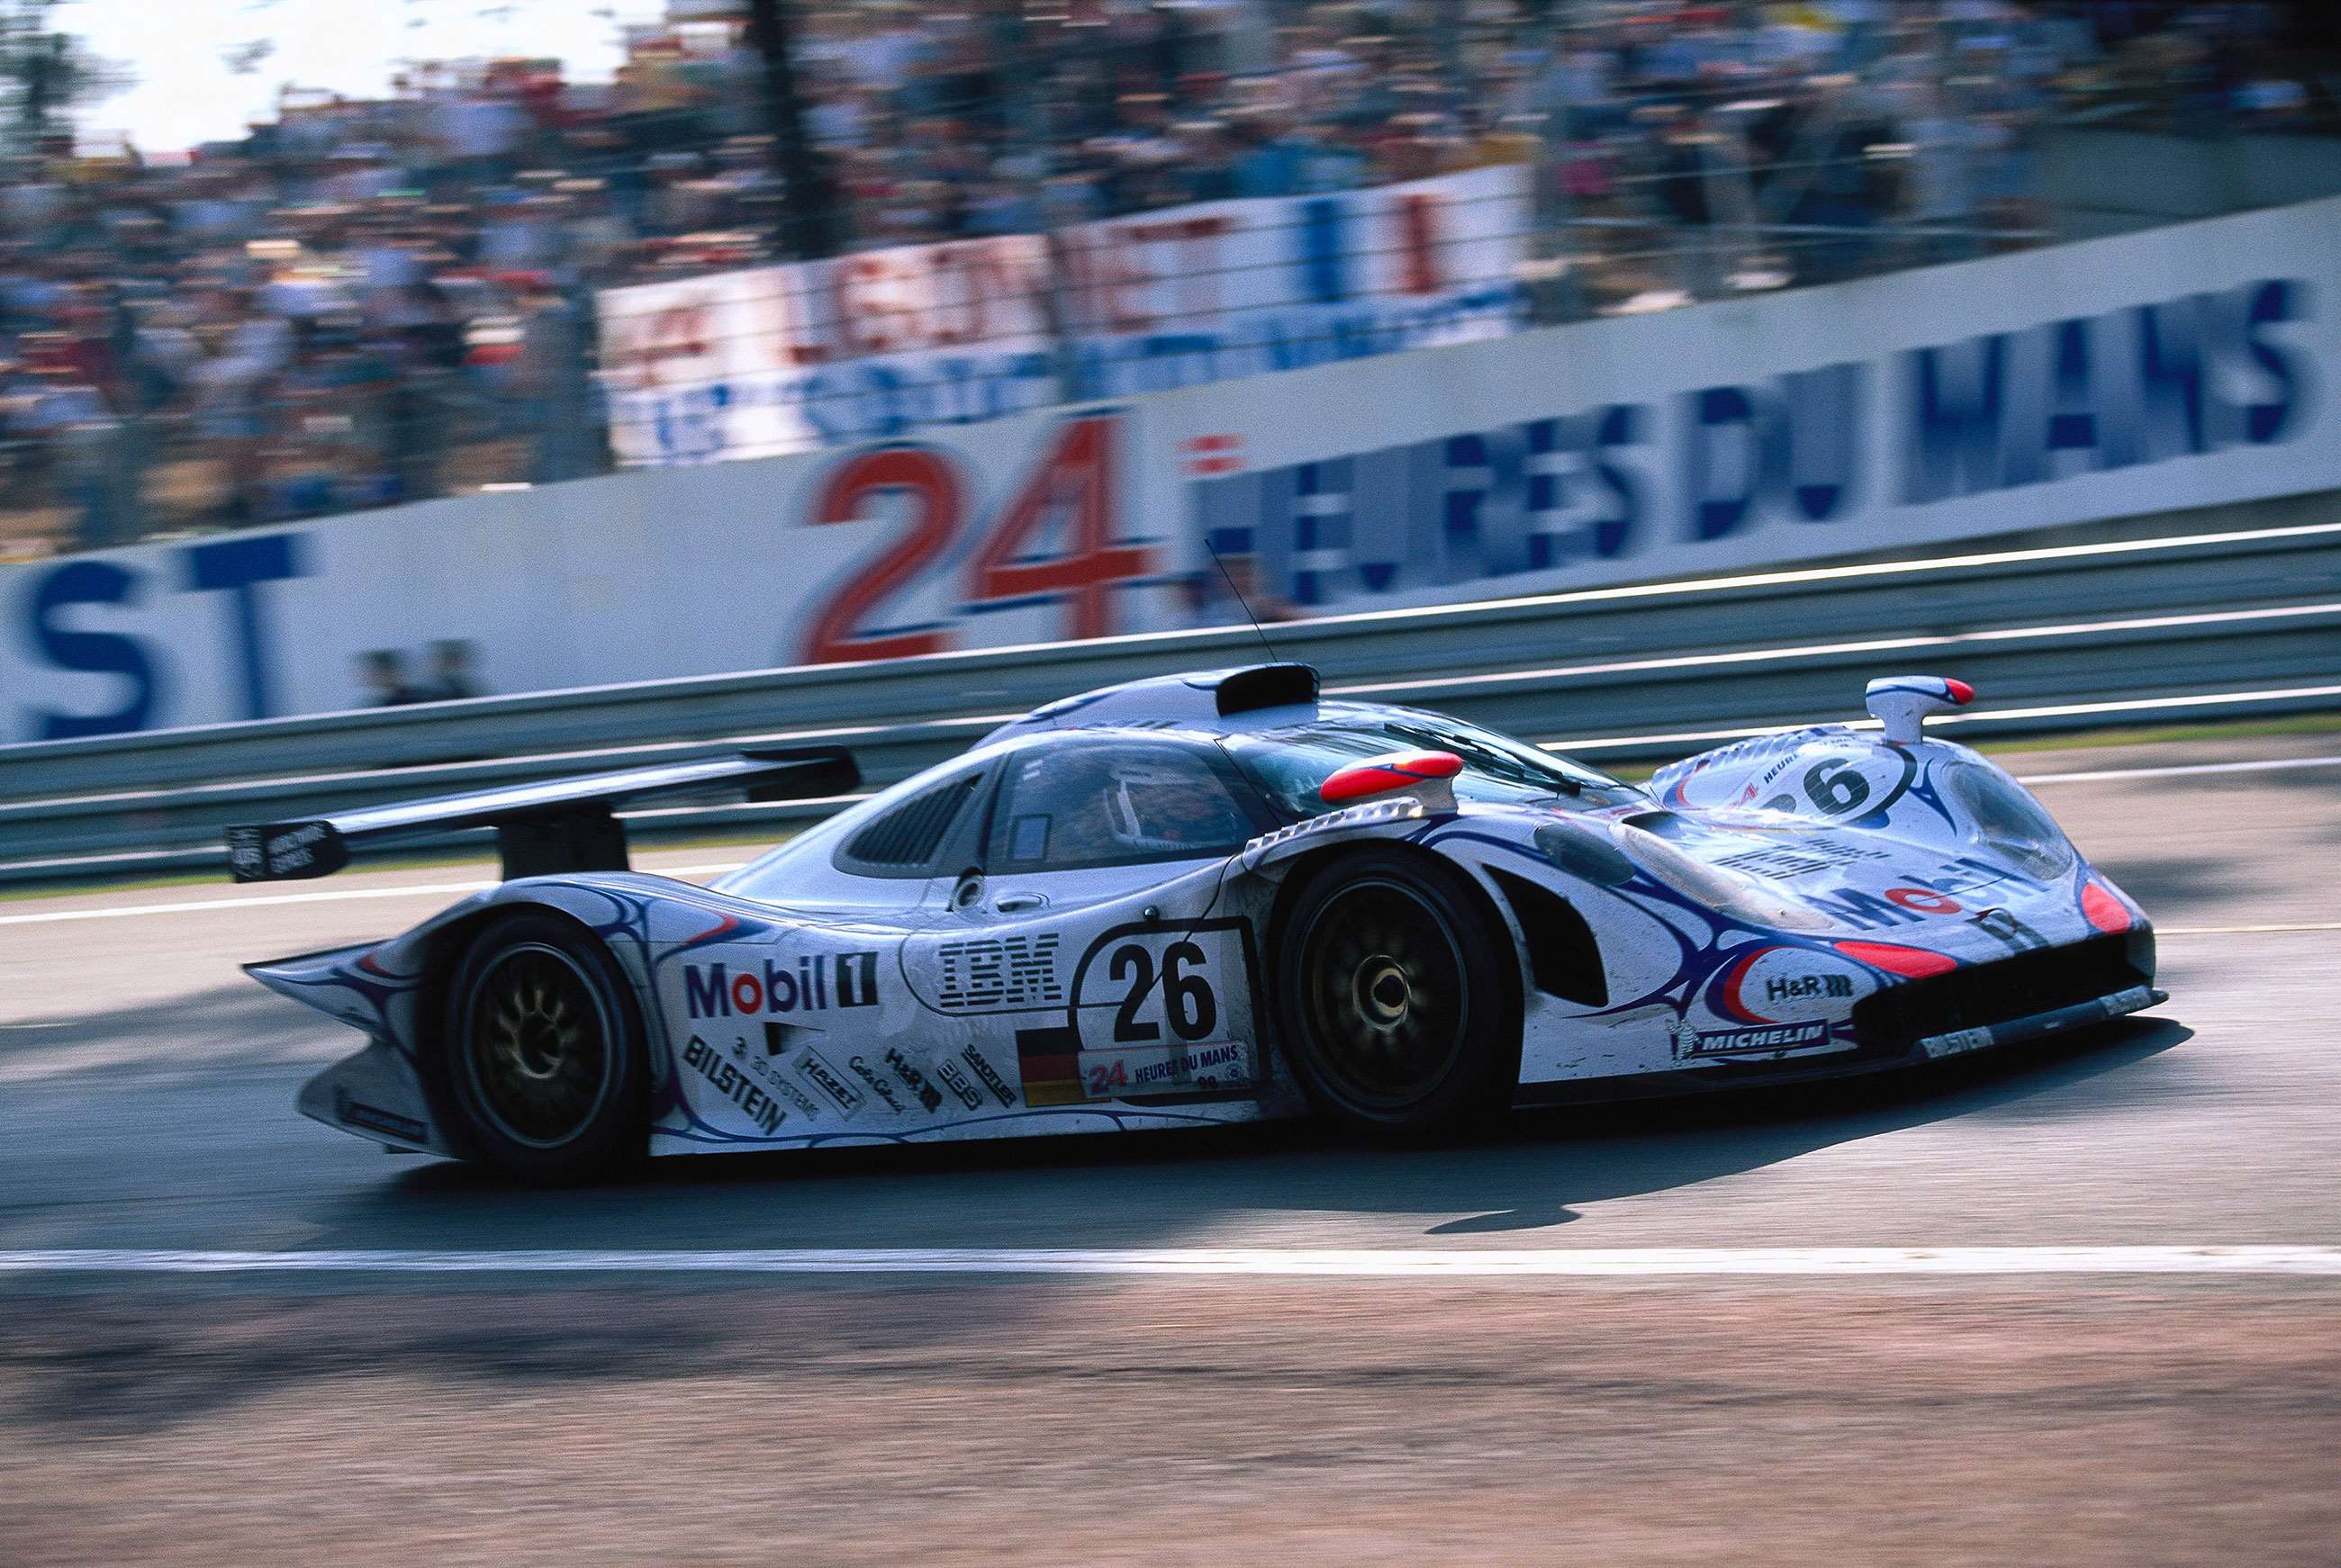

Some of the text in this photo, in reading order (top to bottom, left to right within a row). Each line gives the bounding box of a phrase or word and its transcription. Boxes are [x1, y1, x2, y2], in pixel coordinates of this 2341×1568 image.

[797, 407, 1161, 664] 24
[1193, 405, 1646, 619] HEURES
[1677, 364, 1863, 540] DU
[1898, 279, 2310, 506] MANS
[1799, 858, 2050, 930] Mobil
[684, 956, 827, 1019] Mobil
[939, 933, 1062, 1007] IBM
[1109, 941, 1216, 1042] 26
[1766, 976, 1821, 1000] H&R
[1702, 1024, 1824, 1050] MICHELIN
[682, 1034, 788, 1136] BILSTEIN
[800, 1057, 857, 1108] HAZET
[936, 1057, 983, 1112] BBS
[1089, 1045, 1239, 1095] 24 HEURES DU MANS
